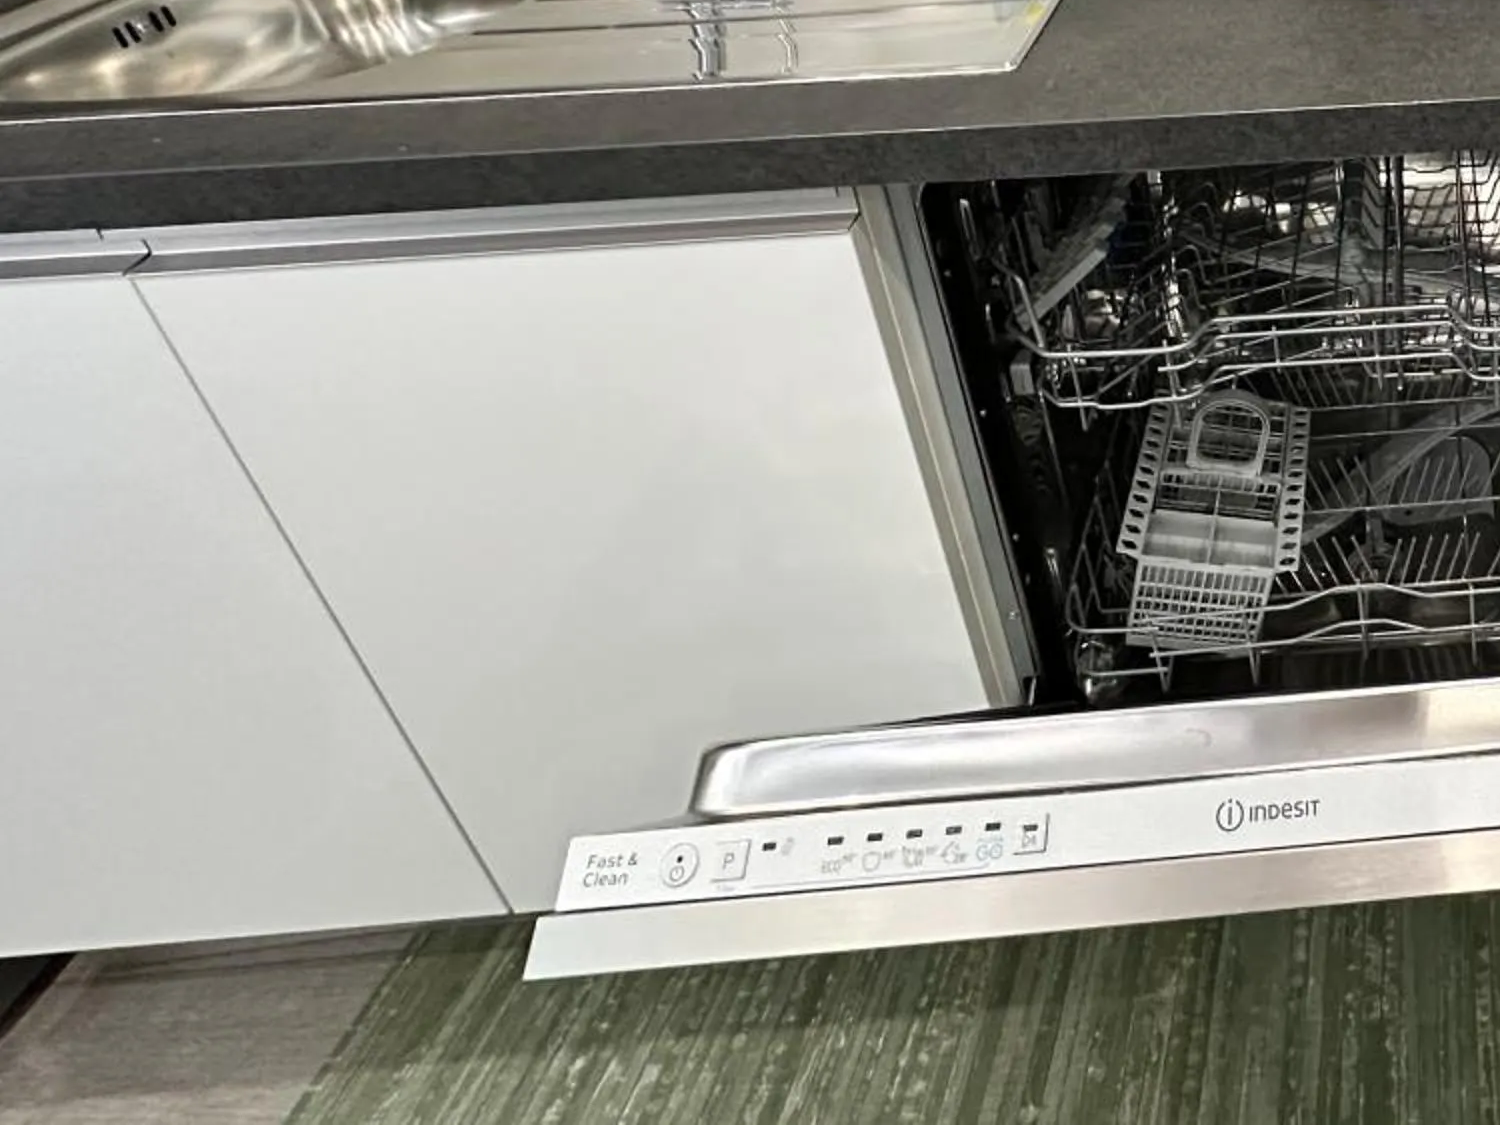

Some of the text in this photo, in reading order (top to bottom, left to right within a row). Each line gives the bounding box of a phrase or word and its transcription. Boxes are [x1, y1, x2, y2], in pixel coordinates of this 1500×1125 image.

[586, 852, 638, 870] Fast &
[723, 852, 735, 870] P
[583, 871, 629, 888] Clean
